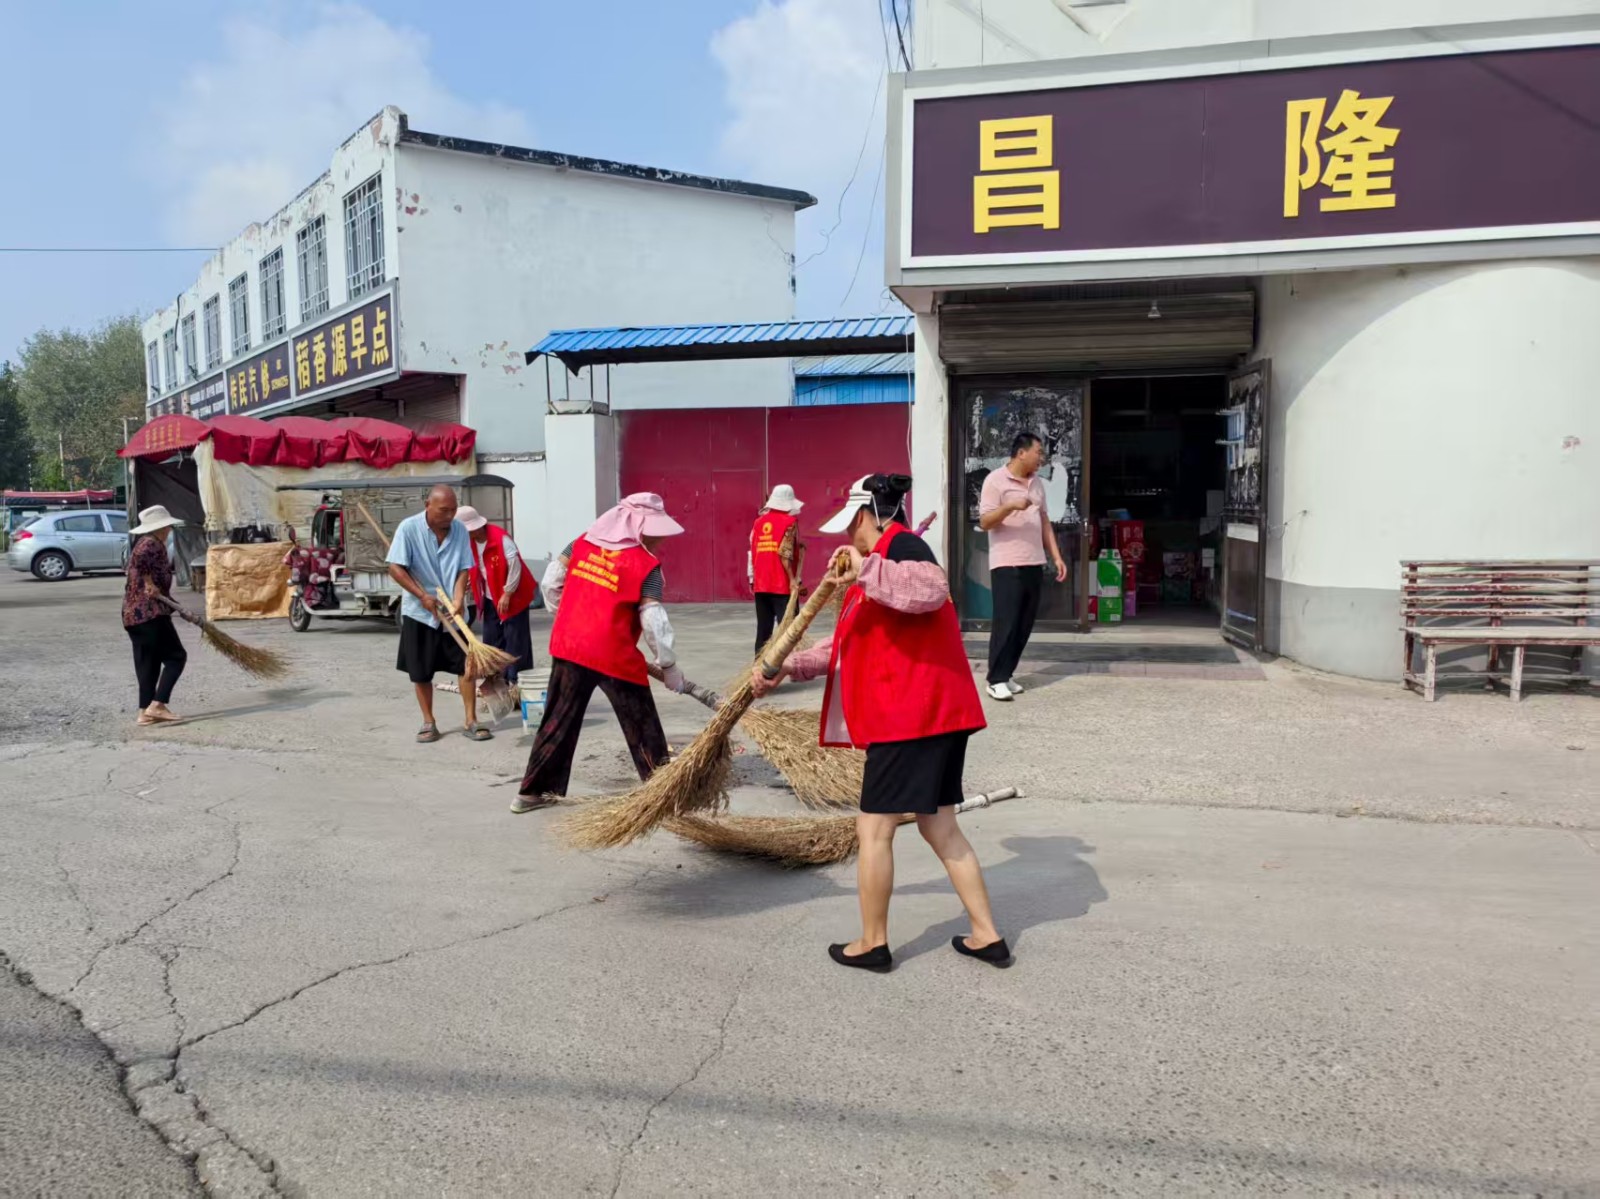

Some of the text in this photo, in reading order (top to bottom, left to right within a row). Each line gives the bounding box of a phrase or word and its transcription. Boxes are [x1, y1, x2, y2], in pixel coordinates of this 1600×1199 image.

[973, 89, 1401, 233] 昌隆
[295, 306, 389, 390] 稻香源早点
